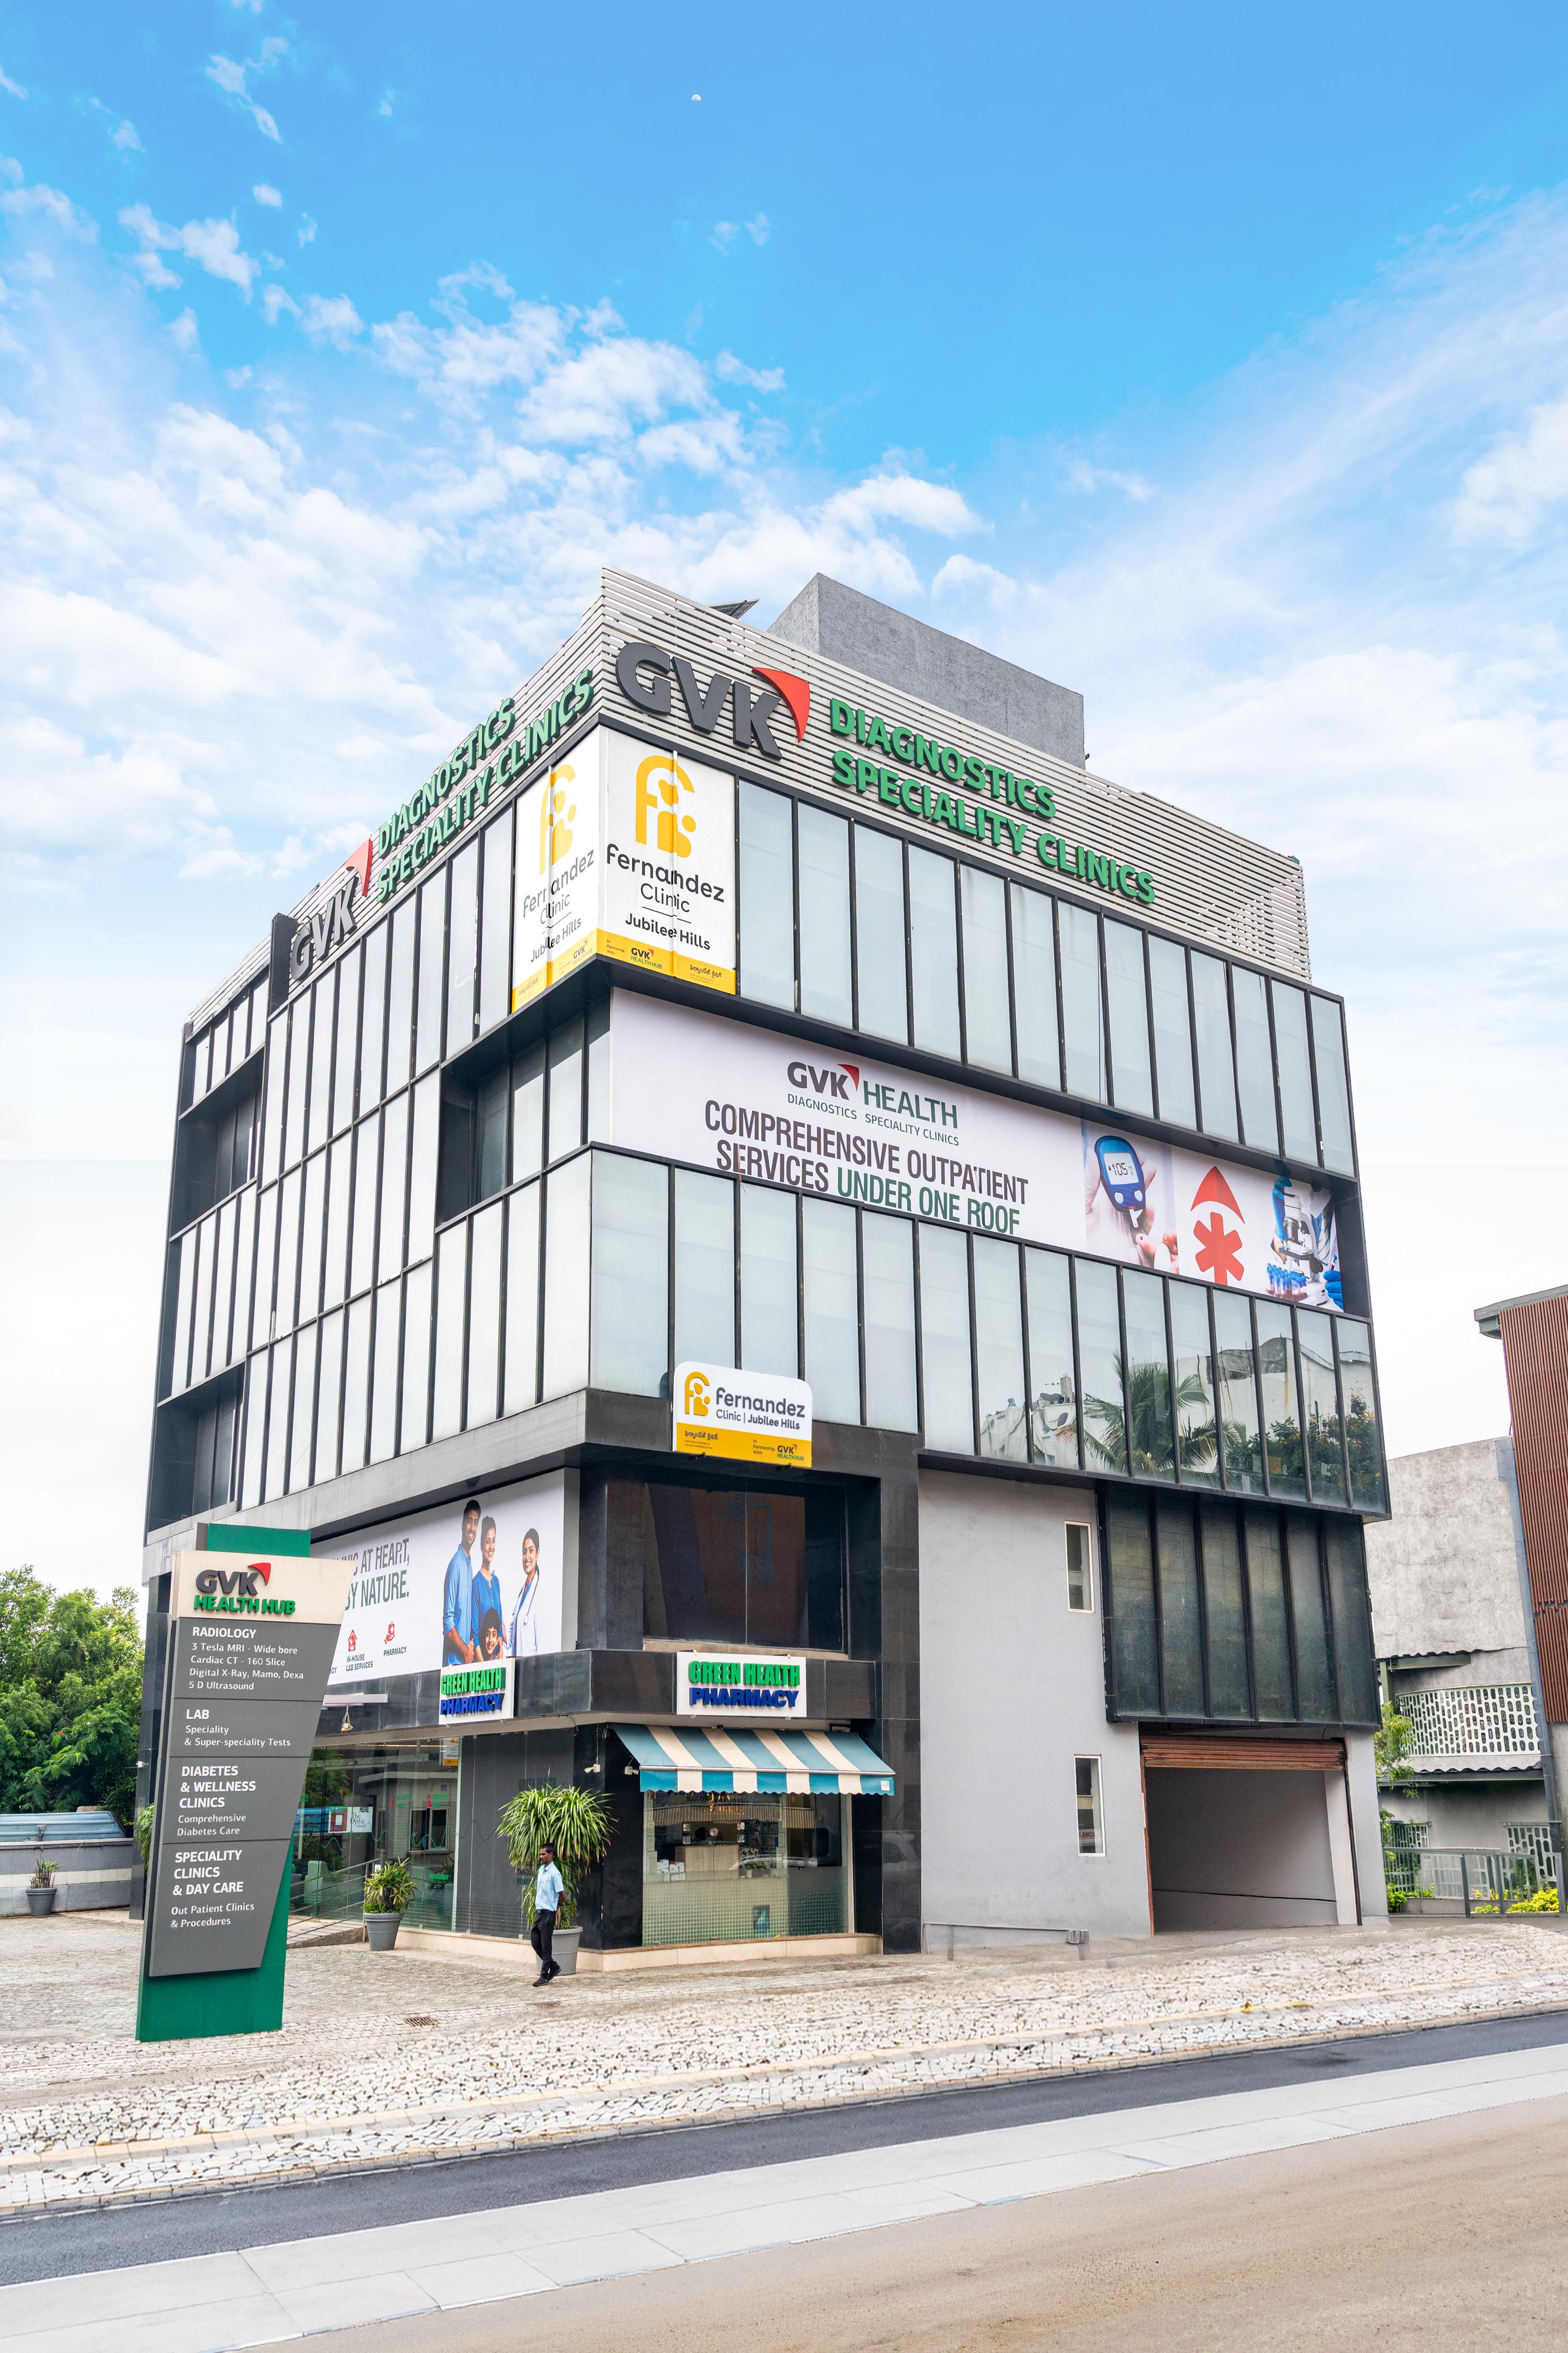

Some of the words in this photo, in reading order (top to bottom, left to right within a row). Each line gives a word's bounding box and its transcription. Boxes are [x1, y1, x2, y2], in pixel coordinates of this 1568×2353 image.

[615, 643, 783, 761] GVK
[830, 697, 1056, 819] DIAGNOSTICS
[378, 697, 515, 859] DIAGNOSTICS
[377, 766, 494, 903] SPECIALITY
[496, 669, 594, 787] CLINICS
[832, 750, 1028, 855] SPECIALITY
[1036, 833, 1155, 904] CLINICS
[641, 883, 690, 912] Clinic
[290, 876, 359, 981] GVK
[563, 918, 581, 940] Hills
[625, 913, 677, 938] Jubilee
[680, 929, 710, 950] Hills
[573, 945, 585, 959] GVK
[631, 947, 650, 960] GVK
[631, 956, 651, 966] HEALTH
[787, 1062, 849, 1101] GVK
[863, 1080, 958, 1129] HEALTH
[788, 1093, 857, 1120] DIAGNOSTICS
[865, 1113, 920, 1136] SPECIALITY
[923, 1128, 959, 1146] CLINICS
[705, 1100, 900, 1174] COMPREHENSIVE
[907, 1149, 1028, 1205] OUTPATIENT
[1112, 1162, 1128, 1176] 105
[716, 1139, 828, 1192] SERVICES
[837, 1167, 912, 1212] UNDER
[919, 1187, 961, 1222] ONE
[967, 1197, 1020, 1235] ROOF
[716, 1409, 741, 1421] Clinic
[748, 1414, 779, 1427] Jubilee
[781, 1419, 800, 1430] Hills
[777, 1445, 794, 1454] GVK
[360, 1549, 373, 1574] AT
[375, 1538, 410, 1570] HEART,
[196, 1570, 258, 1595] GVK
[361, 1570, 409, 1608] NATURE.
[194, 1595, 260, 1613] HEALTH
[262, 1599, 296, 1614] HUB
[192, 1626, 257, 1639] RADIOLOGY
[192, 1643, 197, 1651] 3
[200, 1643, 224, 1652] Tesla
[227, 1644, 245, 1652] MRI
[254, 1645, 276, 1653] Wide
[278, 1645, 298, 1654] bore
[383, 1646, 407, 1657] PHARMACY
[191, 1655, 224, 1664] Cardiac
[227, 1656, 239, 1665] CT
[266, 1658, 286, 1666] Slice
[347, 1654, 365, 1663] IN-HOUSE
[189, 1667, 219, 1678] Digital
[221, 1669, 249, 1679] X-Ray,
[252, 1670, 281, 1679] Mamo,
[283, 1670, 304, 1679] Dexa
[354, 1661, 373, 1671] SERVICES
[688, 1661, 741, 1684] GREEN
[744, 1663, 800, 1686] HEALTH
[206, 1681, 254, 1690] Ultrasound
[441, 1672, 469, 1695] GREEN
[469, 1667, 506, 1692] HEALTH
[440, 1692, 505, 1715] PHARMACY
[689, 1687, 799, 1708] PHARMACY
[186, 1709, 210, 1720] LAB
[185, 1725, 229, 1735] Speciality
[184, 1738, 192, 1746] &
[195, 1738, 266, 1748] Super-speciality
[182, 1765, 239, 1777] DIABETES
[180, 1782, 190, 1793] &
[193, 1781, 256, 1792] WELLNESS
[179, 1796, 225, 1808] CLINICS
[178, 1813, 247, 1825] Comprehensive
[177, 1827, 217, 1836] Diabetes
[219, 1826, 240, 1835] Care
[175, 1850, 243, 1863] SPECIALITY
[174, 1867, 221, 1880] CLINICS
[172, 1885, 183, 1896] &
[185, 1883, 210, 1895] DAY
[213, 1881, 244, 1894] CARE
[171, 1906, 188, 1915] Out
[191, 1904, 223, 1914] Patient
[226, 1902, 254, 1912] Clinics
[171, 1919, 178, 1928] &
[180, 1917, 231, 1928] Procedures
